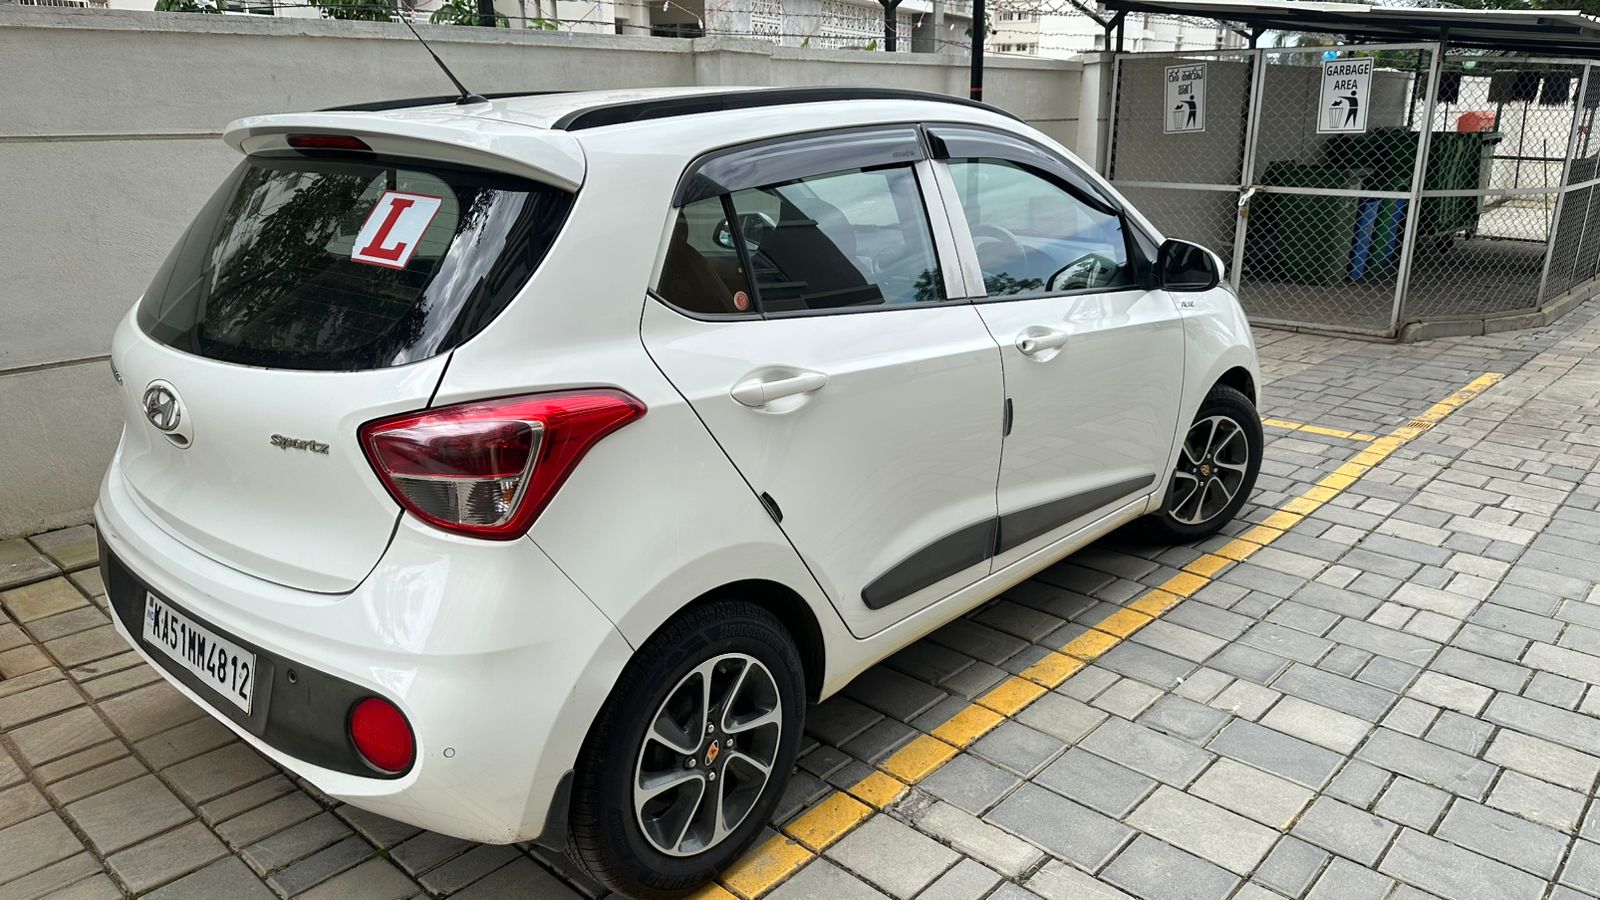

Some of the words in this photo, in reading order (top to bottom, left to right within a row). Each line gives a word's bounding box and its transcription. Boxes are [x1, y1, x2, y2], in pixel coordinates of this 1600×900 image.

[1326, 64, 1369, 76] GARBAGE
[1333, 79, 1358, 91] AREA
[360, 198, 414, 261] L
[269, 433, 330, 455] Sportz
[152, 602, 250, 701] KA51MM4812
